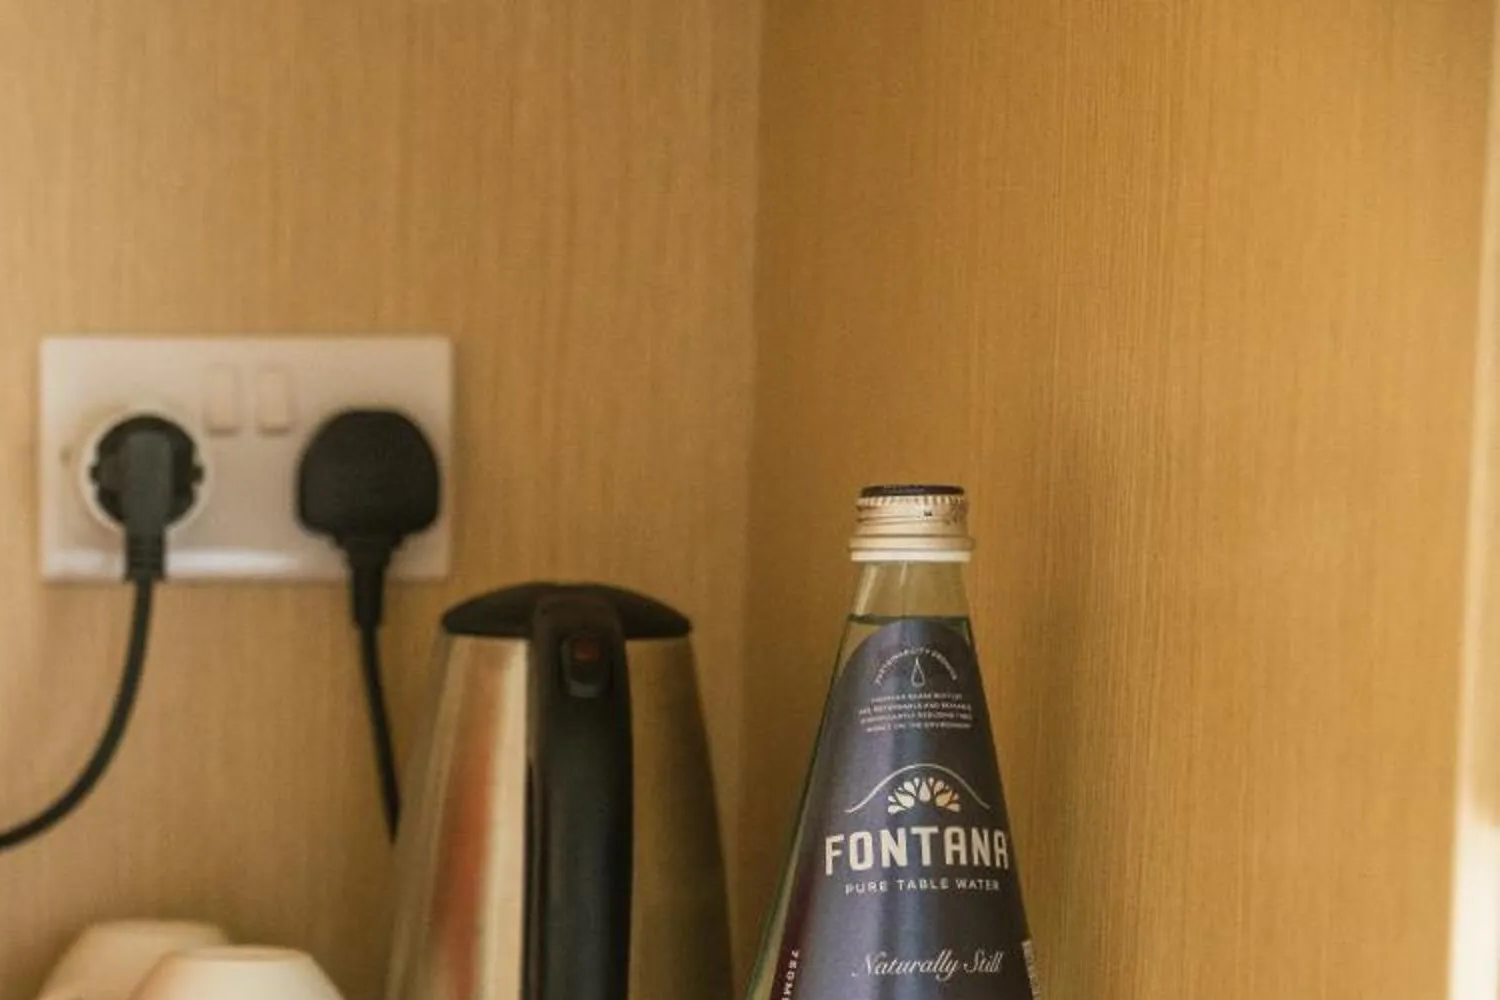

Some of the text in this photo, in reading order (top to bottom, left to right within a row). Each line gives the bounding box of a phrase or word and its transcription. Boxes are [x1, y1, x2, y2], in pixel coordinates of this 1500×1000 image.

[825, 825, 1009, 876] FONTANA
[845, 878, 1000, 895] PURE TABLE WATER
[851, 949, 1003, 982] Naturally Still
